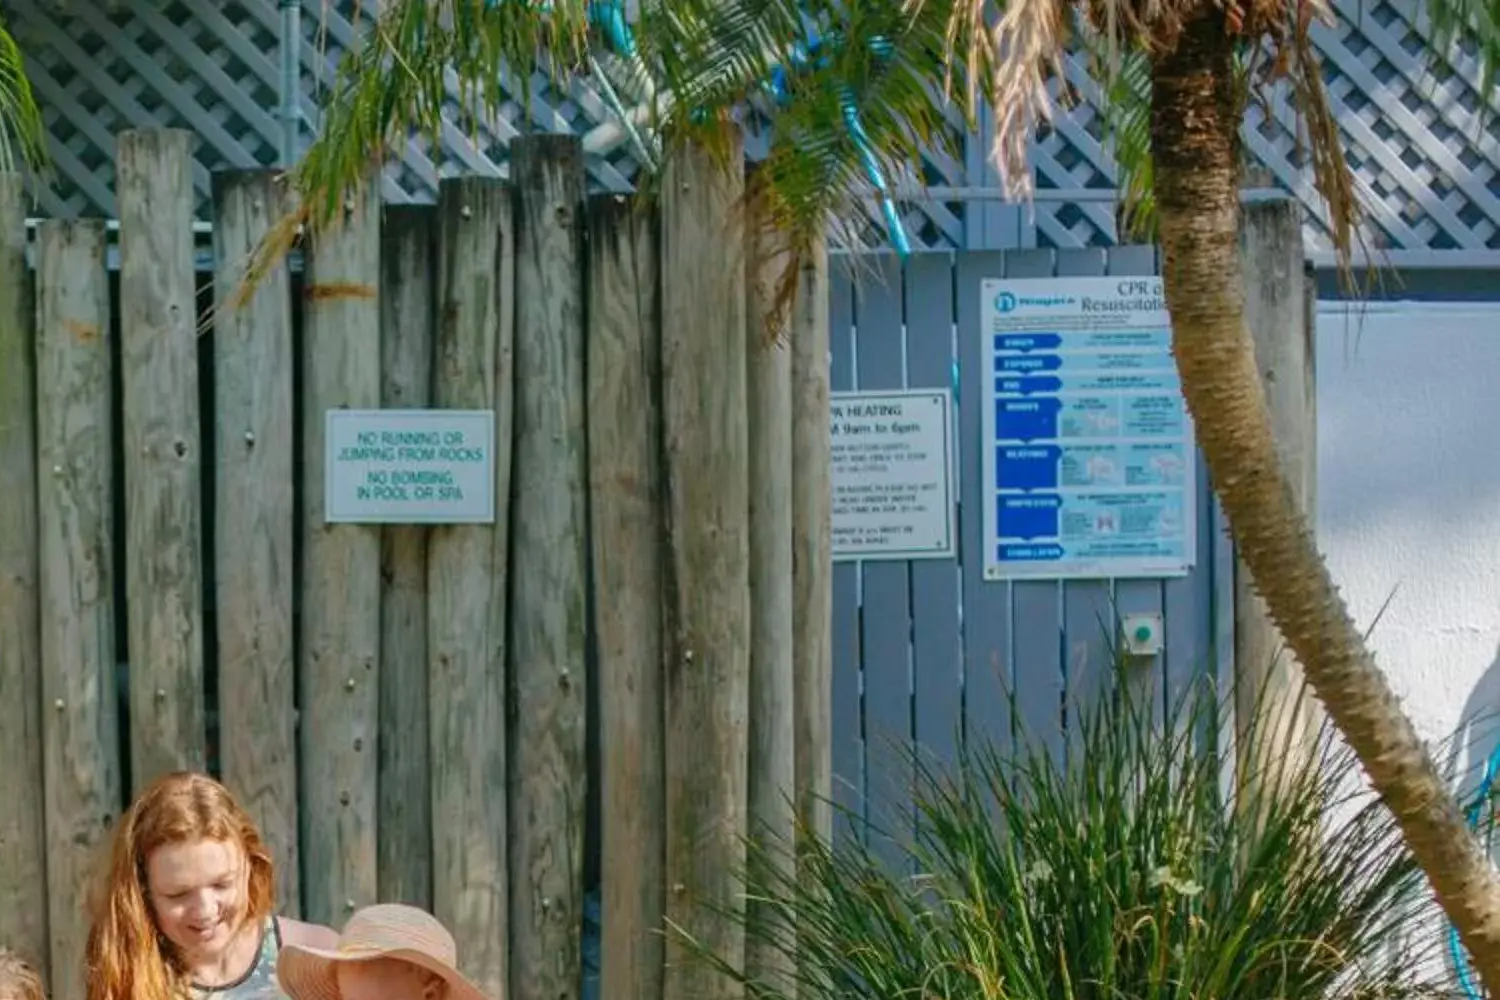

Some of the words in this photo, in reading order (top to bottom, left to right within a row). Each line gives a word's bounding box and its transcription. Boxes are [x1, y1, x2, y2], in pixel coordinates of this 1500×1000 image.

[1117, 281, 1148, 296] CPR
[847, 405, 902, 417] HEATING
[357, 431, 378, 445] NO
[382, 431, 440, 445] RUNNING
[443, 431, 464, 445] OR
[338, 446, 396, 461] JUMPING
[398, 446, 436, 461] FROM
[439, 447, 484, 461] ROCKS
[367, 470, 387, 485] NO
[391, 470, 453, 485] BOMBING
[357, 486, 371, 500] IN
[373, 486, 409, 500] POOL
[414, 486, 434, 500] OR
[438, 486, 464, 500] SPA
